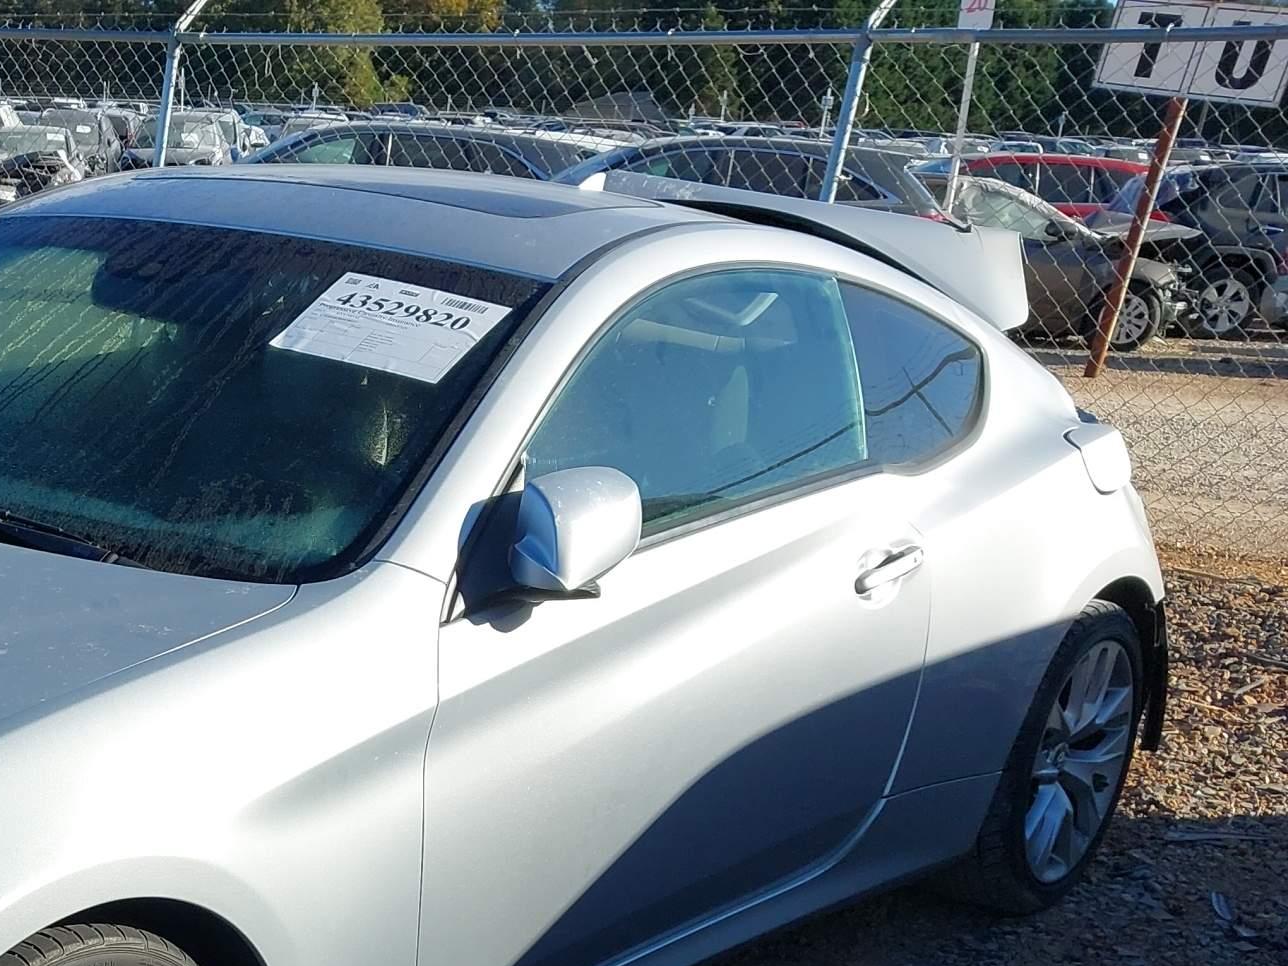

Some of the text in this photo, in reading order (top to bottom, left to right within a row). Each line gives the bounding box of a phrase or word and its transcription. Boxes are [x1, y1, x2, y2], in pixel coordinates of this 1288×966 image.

[1134, 11, 1280, 90] T U
[336, 292, 472, 330] 43529820
